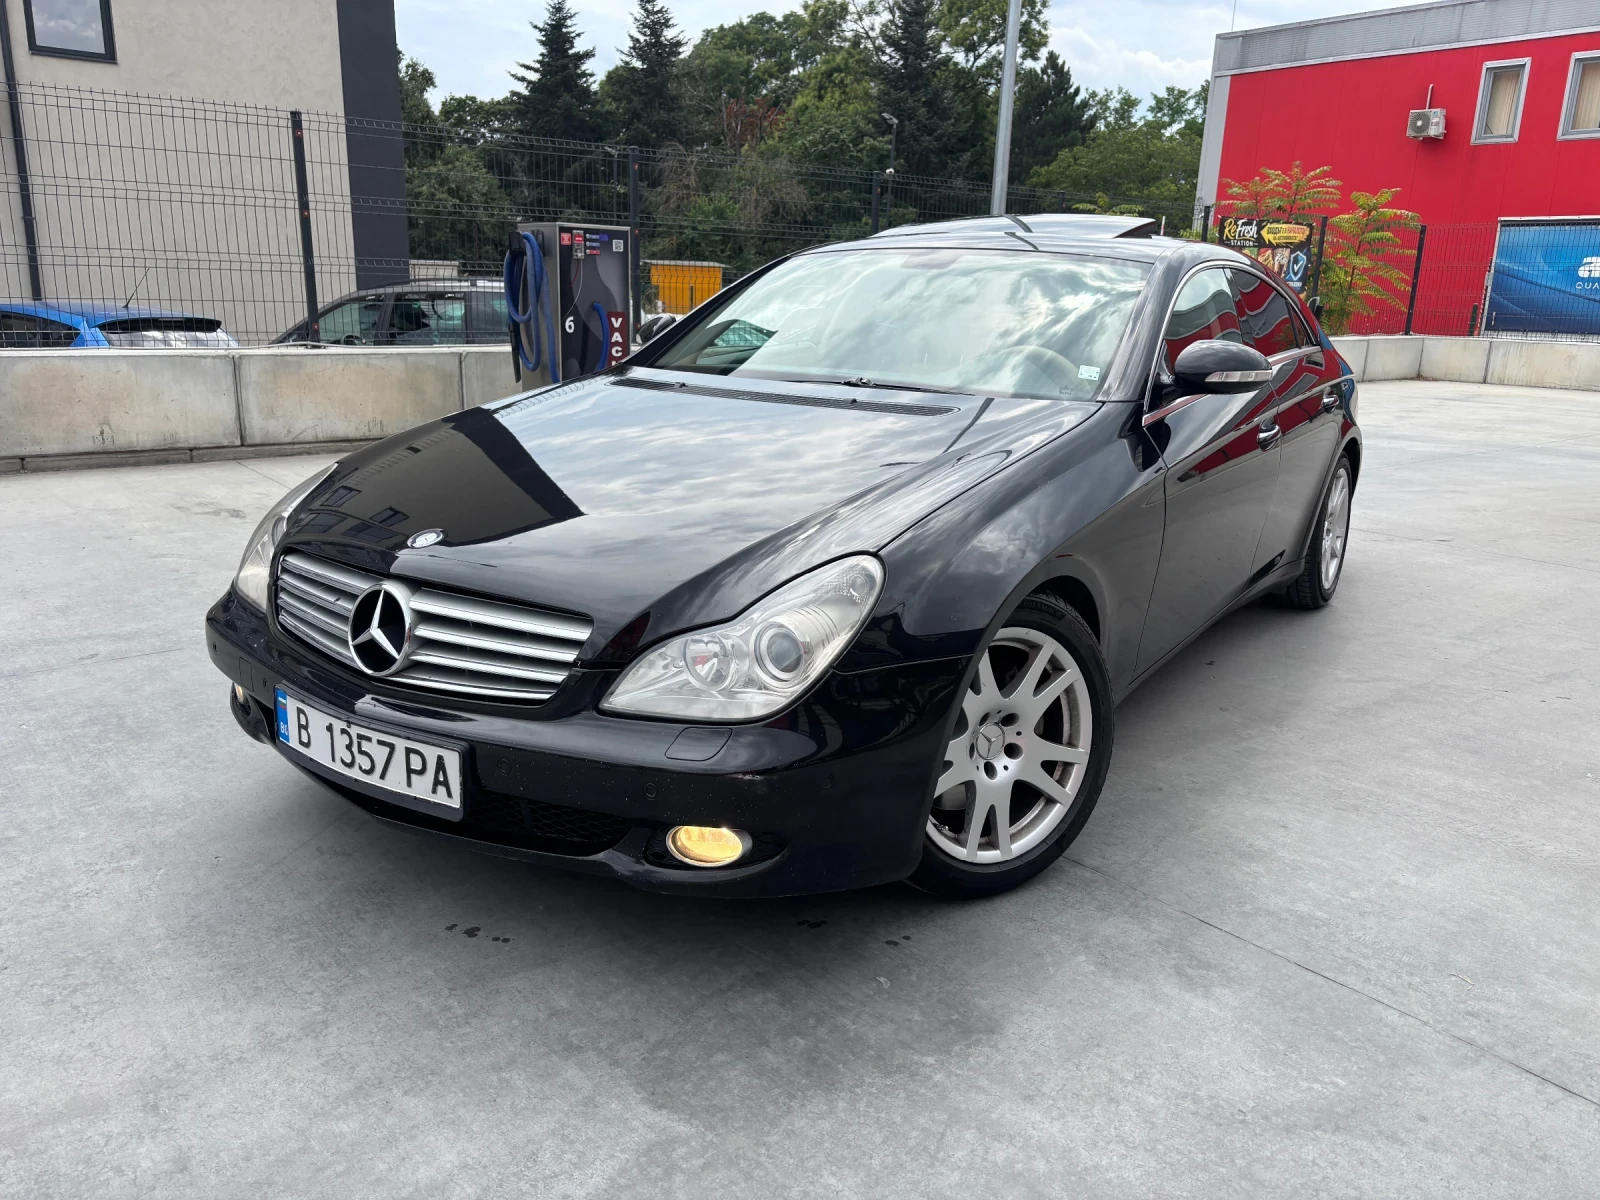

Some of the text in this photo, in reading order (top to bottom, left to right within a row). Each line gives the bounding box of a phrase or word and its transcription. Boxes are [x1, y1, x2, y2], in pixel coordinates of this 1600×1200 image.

[1224, 219, 1258, 240] ReFresh
[565, 316, 575, 333] 6
[296, 706, 453, 799] B 1357 PA
